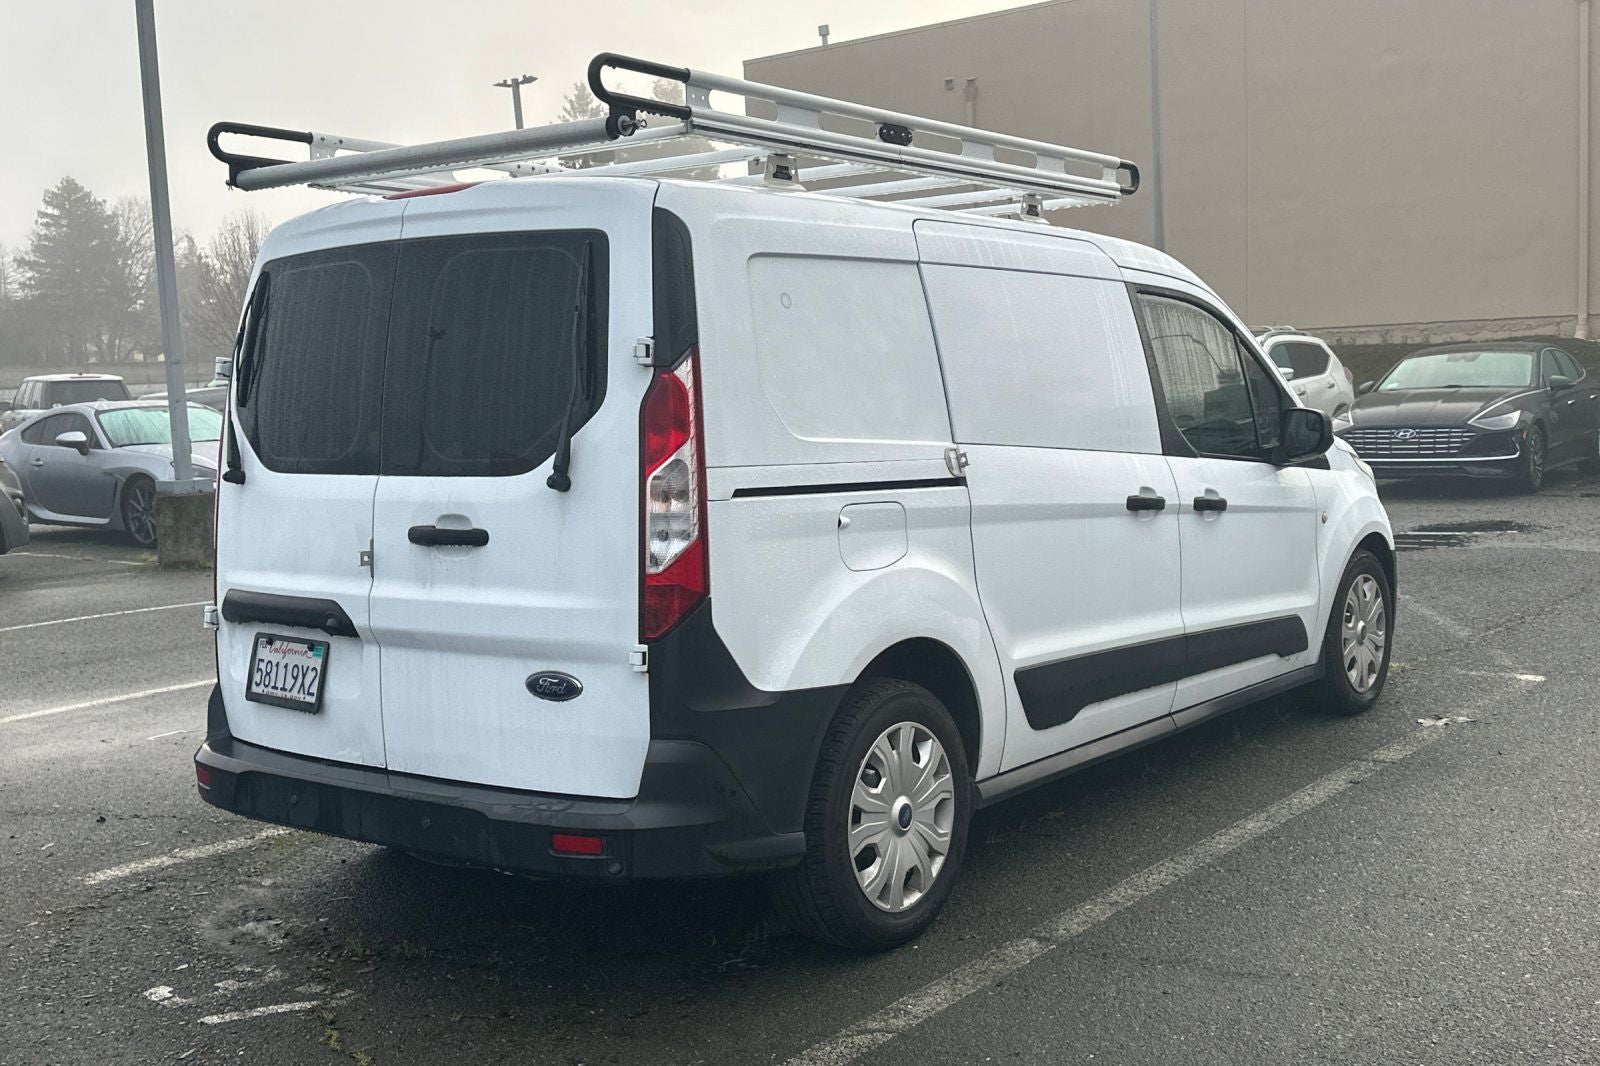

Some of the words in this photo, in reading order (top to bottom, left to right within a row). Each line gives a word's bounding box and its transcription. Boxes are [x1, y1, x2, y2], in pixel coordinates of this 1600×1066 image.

[268, 641, 312, 660] California
[255, 658, 318, 696] 58119X2
[536, 677, 567, 694] Ford
